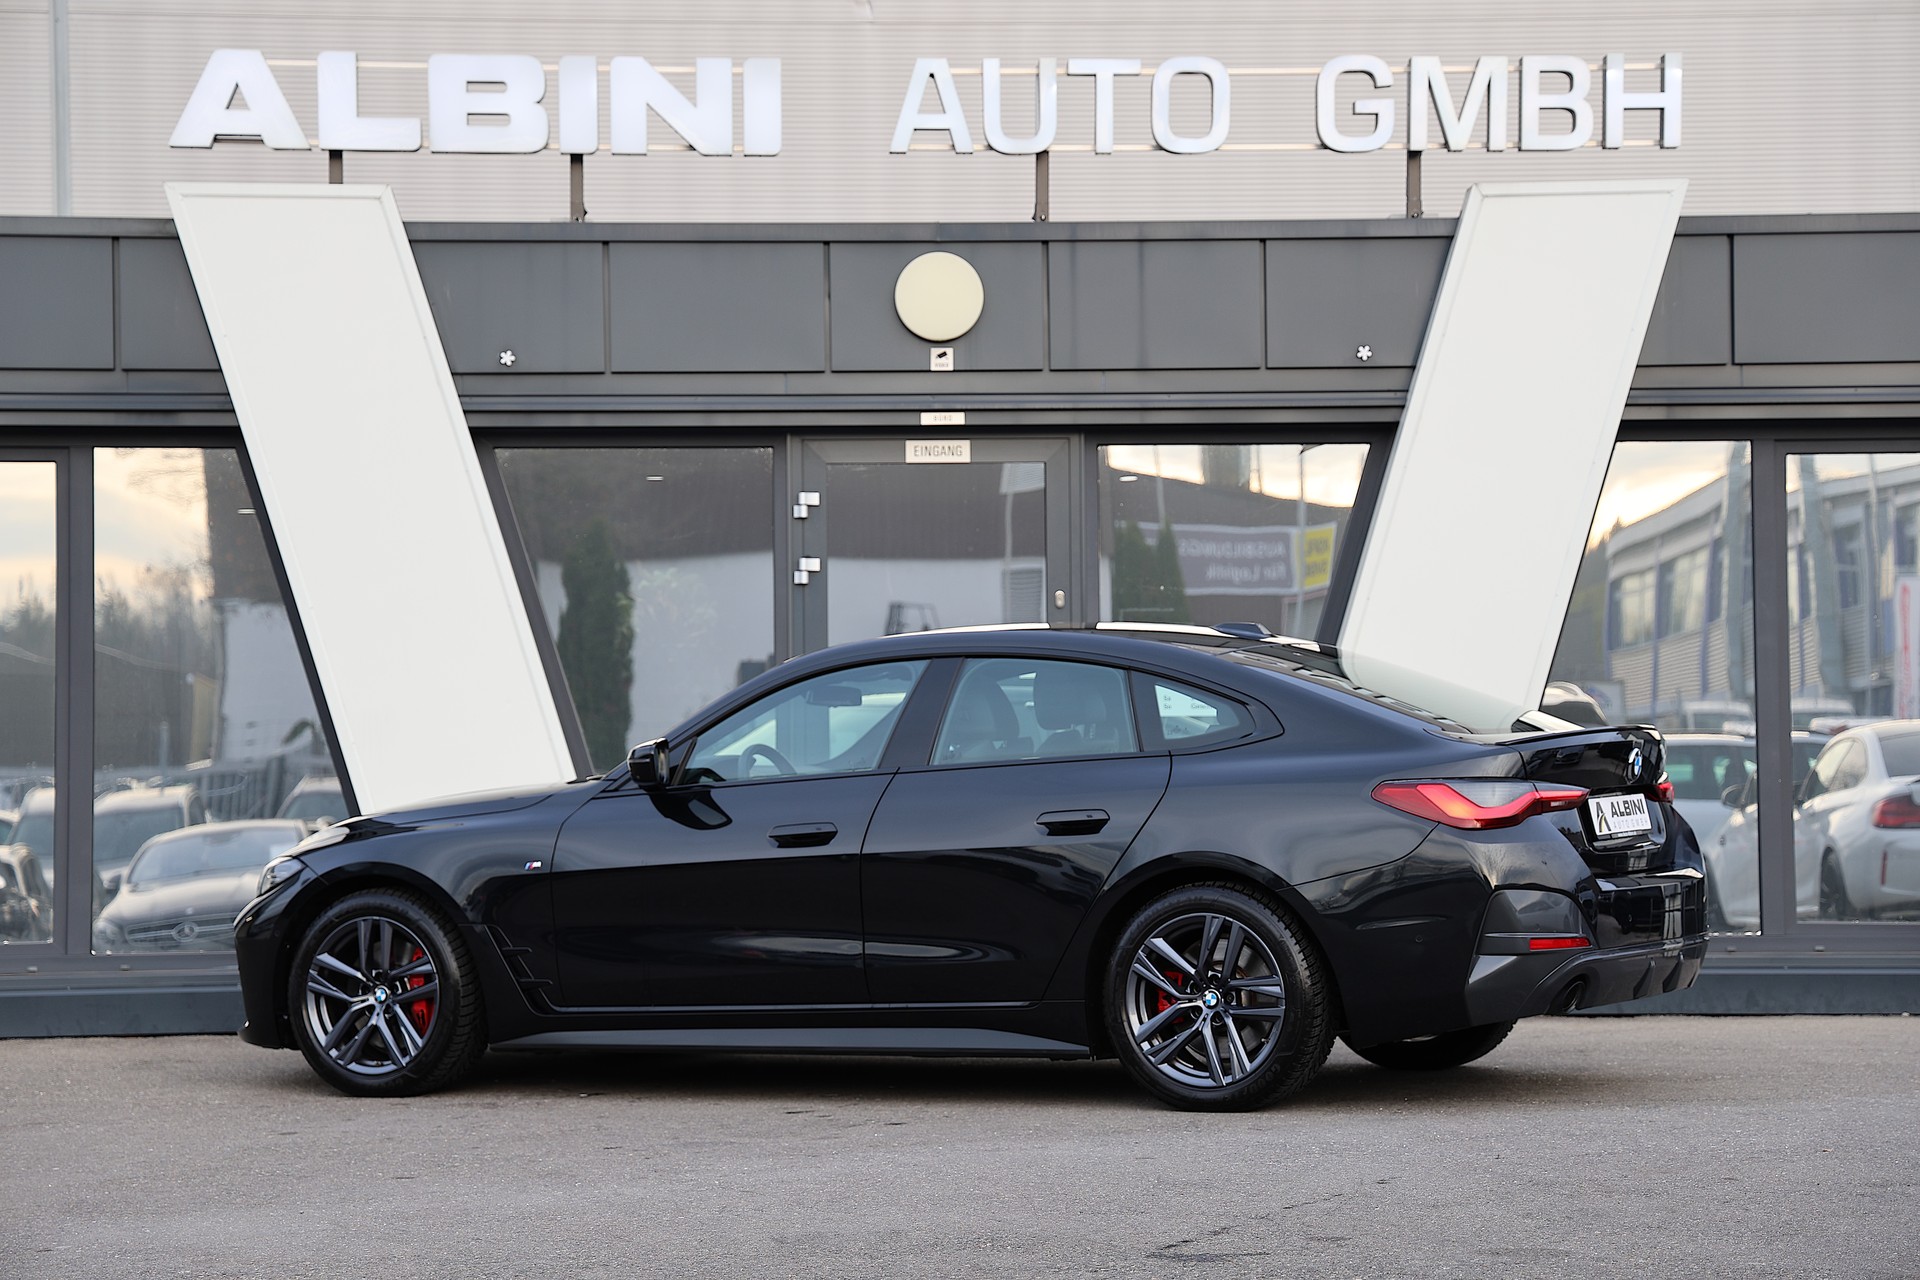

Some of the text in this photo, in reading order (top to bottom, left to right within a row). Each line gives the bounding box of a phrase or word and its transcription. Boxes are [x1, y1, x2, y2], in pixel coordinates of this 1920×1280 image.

[169, 48, 1683, 156] ALBINI AUTO GMBH
[913, 444, 963, 457] EINGANG
[1610, 798, 1645, 818] ALBINI
